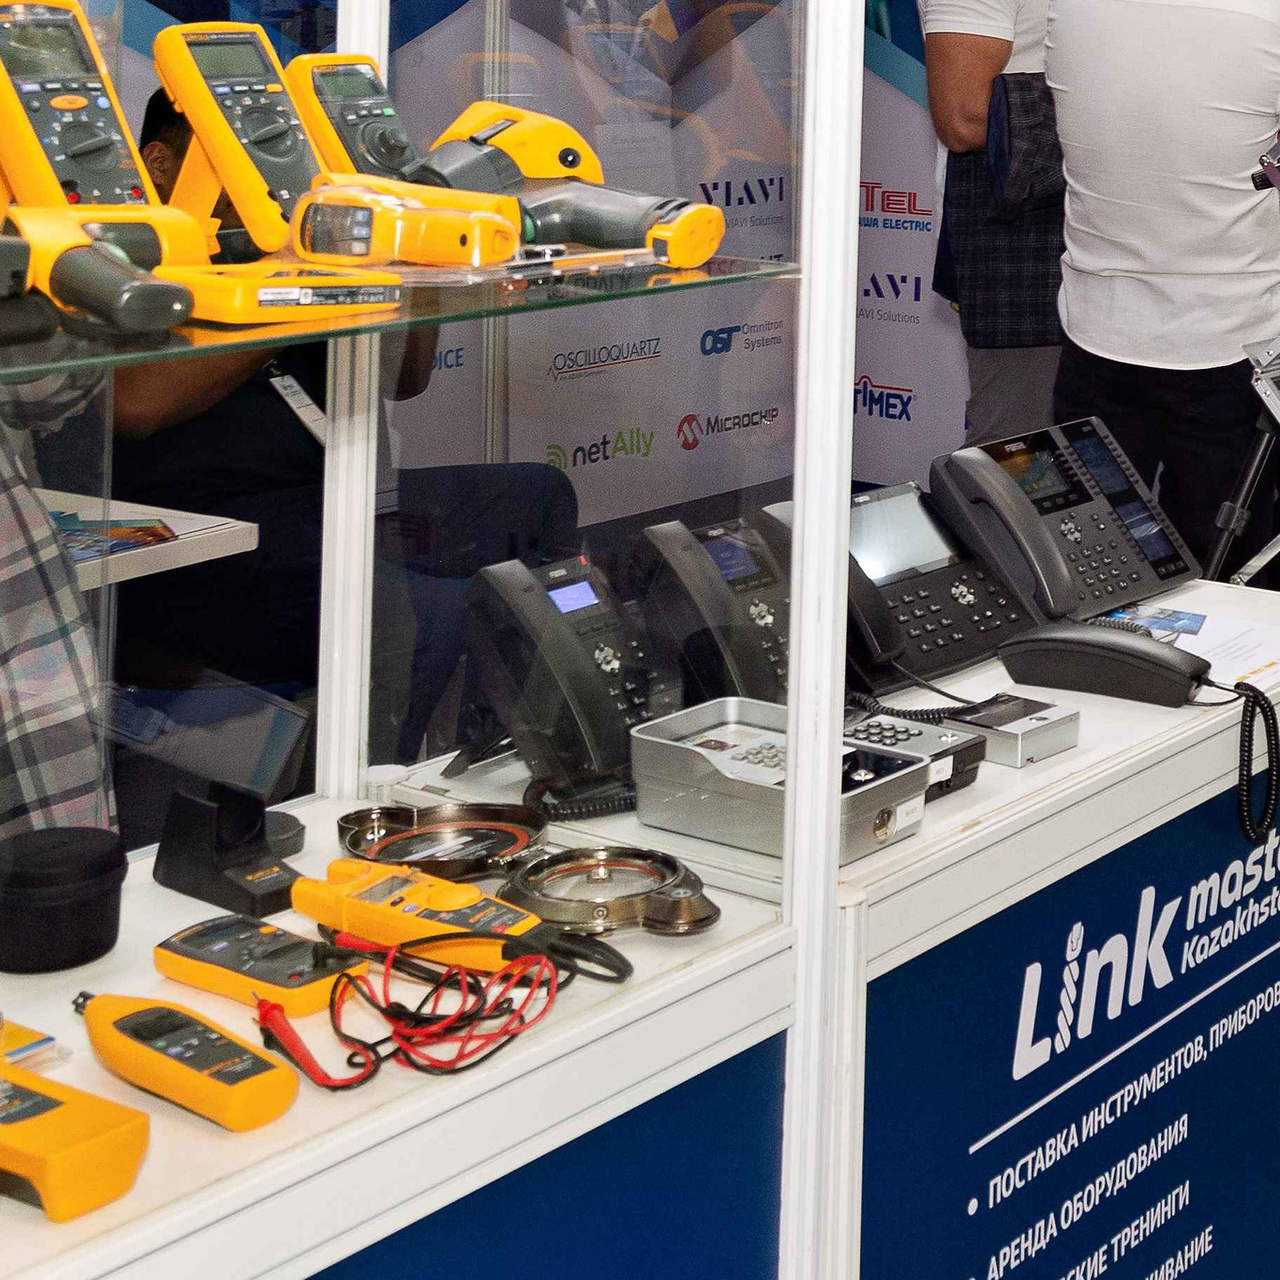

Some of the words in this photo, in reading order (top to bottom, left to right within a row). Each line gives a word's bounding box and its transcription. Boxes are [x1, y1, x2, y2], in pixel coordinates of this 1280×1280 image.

[860, 181, 933, 216] TEL
[883, 218, 932, 232] ELECTRIC
[863, 272, 922, 302] AVI
[877, 310, 920, 325] Solutions
[553, 338, 662, 372] OSCILLOQUARTZ
[744, 334, 783, 351] Systems
[573, 426, 655, 468] netAlly
[1012, 886, 1183, 1081] Link
[988, 1122, 1079, 1210] ПОСТАВКА
[1081, 1034, 1208, 1143] ИНСТРУМЕНТОВ,
[986, 1212, 1058, 1280] АРЕНДА
[1060, 1113, 1189, 1230] ОБОРУДОВАНИЯ
[1111, 1179, 1190, 1263] ТРЕНИНГИ
